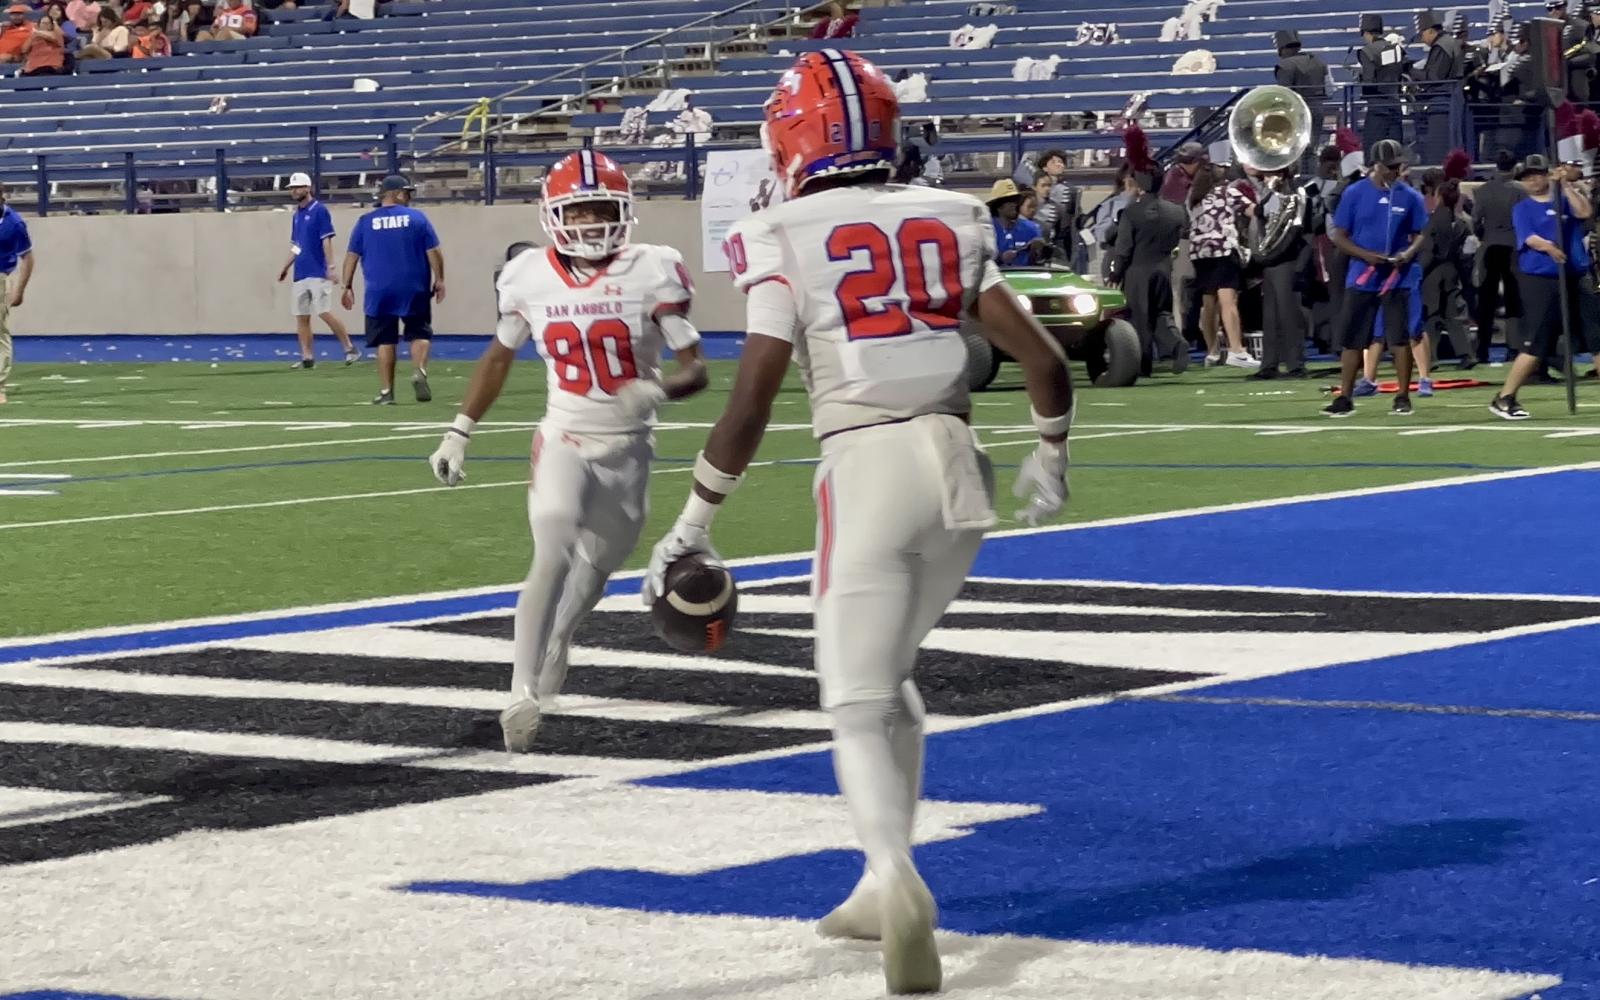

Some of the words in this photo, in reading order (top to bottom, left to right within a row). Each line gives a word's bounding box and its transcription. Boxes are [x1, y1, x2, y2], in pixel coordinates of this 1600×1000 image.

[372, 215, 410, 230] STAFF
[825, 217, 963, 341] 20
[545, 304, 569, 318] SAN
[574, 301, 623, 316] ANGELO
[543, 318, 638, 395] 80
